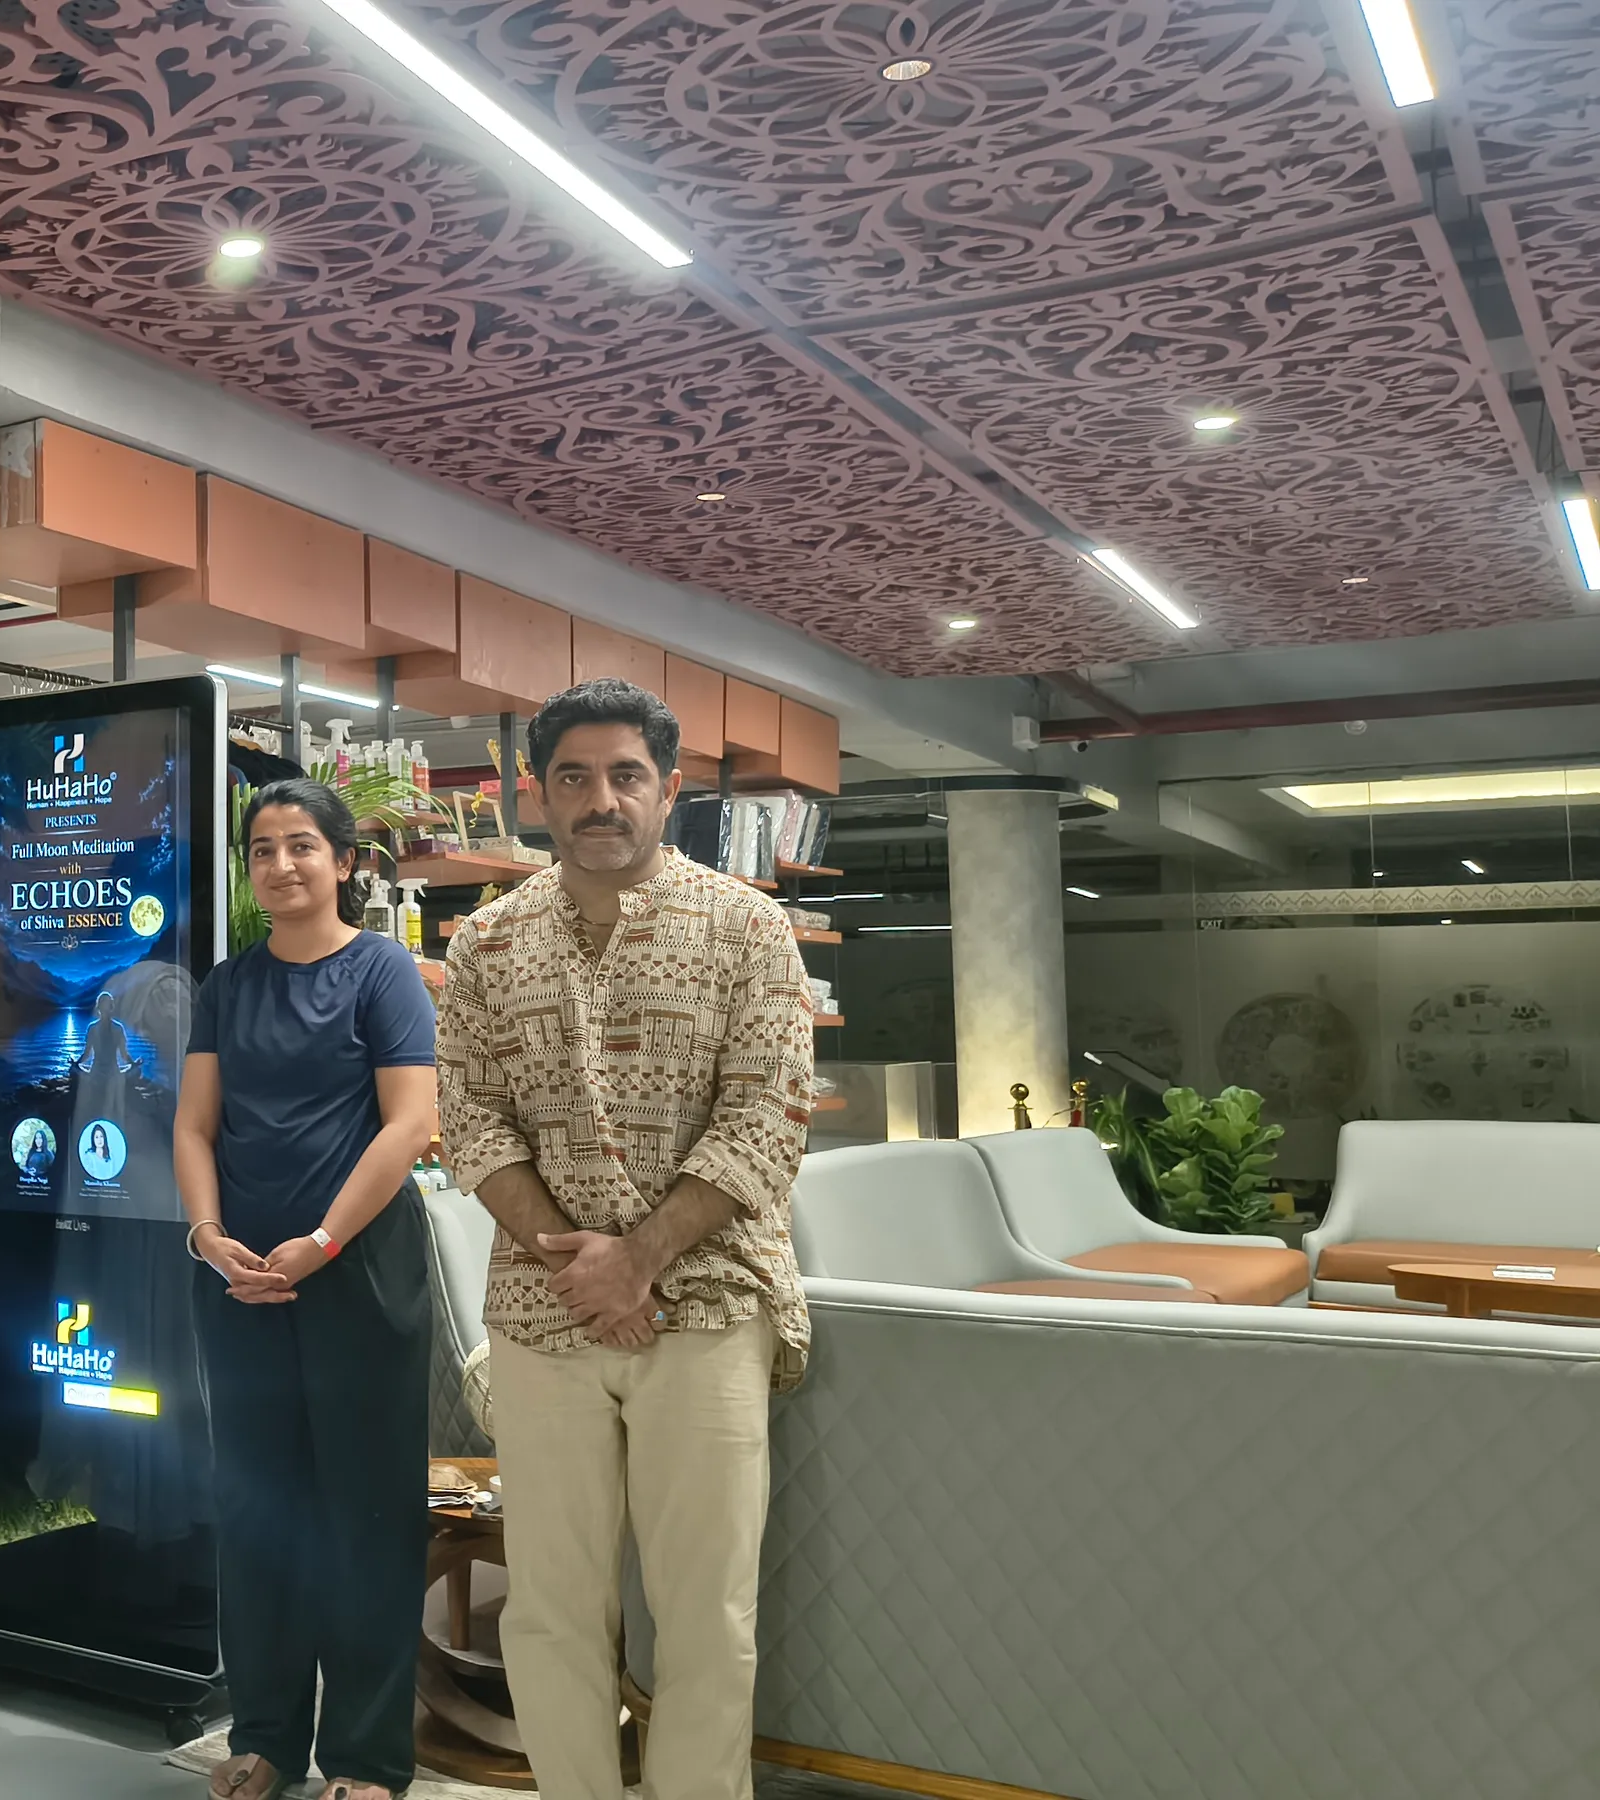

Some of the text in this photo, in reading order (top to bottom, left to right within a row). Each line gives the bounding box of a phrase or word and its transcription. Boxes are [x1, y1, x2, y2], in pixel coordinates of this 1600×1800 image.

[26, 773, 113, 801] HuHaHo
[45, 813, 97, 828] PRESENTS
[11, 837, 134, 859] Full Moon Meditation
[59, 862, 82, 875] with
[11, 877, 133, 911] ECHOES
[20, 912, 123, 930] of Shiva ESSENCE
[1200, 919, 1223, 930] EXIT
[31, 1342, 113, 1372] HuHaHo
